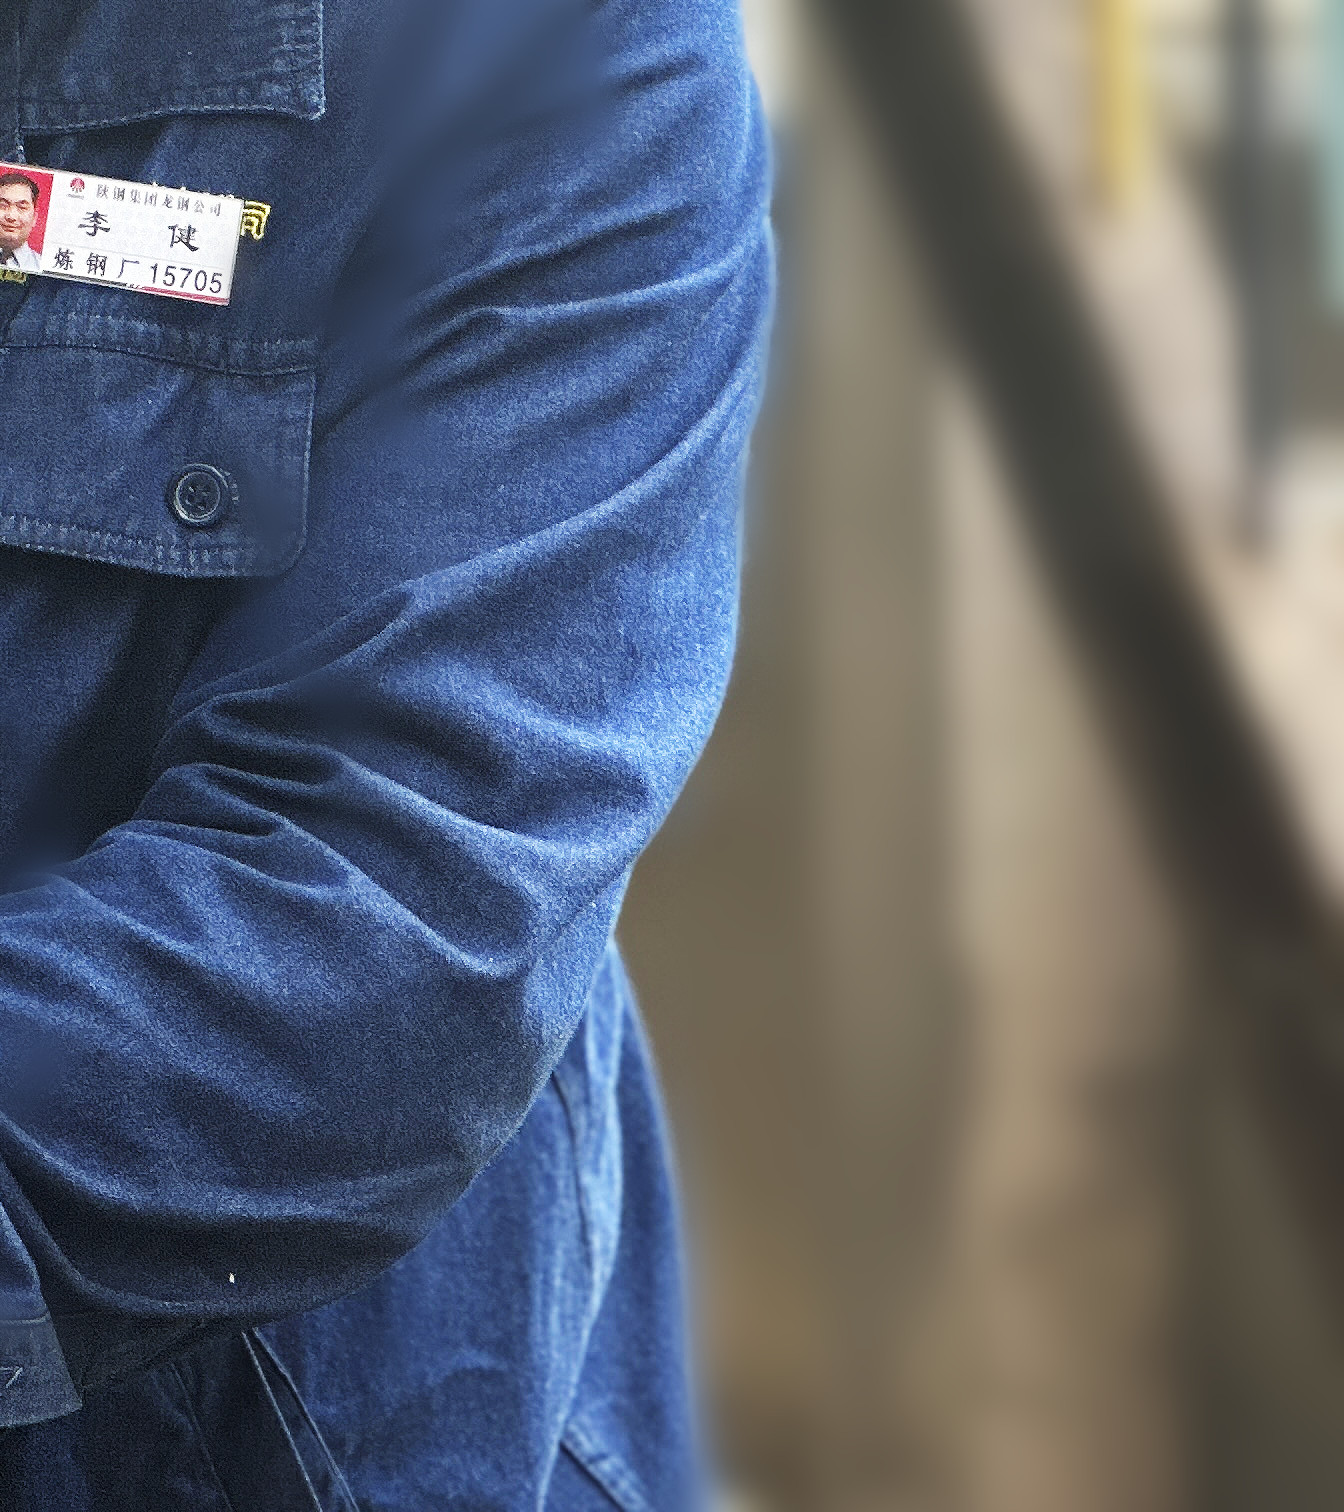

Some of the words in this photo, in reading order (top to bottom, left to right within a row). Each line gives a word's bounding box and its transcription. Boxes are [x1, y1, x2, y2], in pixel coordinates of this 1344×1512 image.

[96, 183, 222, 217] 陕钢集团龙钢公司
[150, 262, 223, 294] 15705
